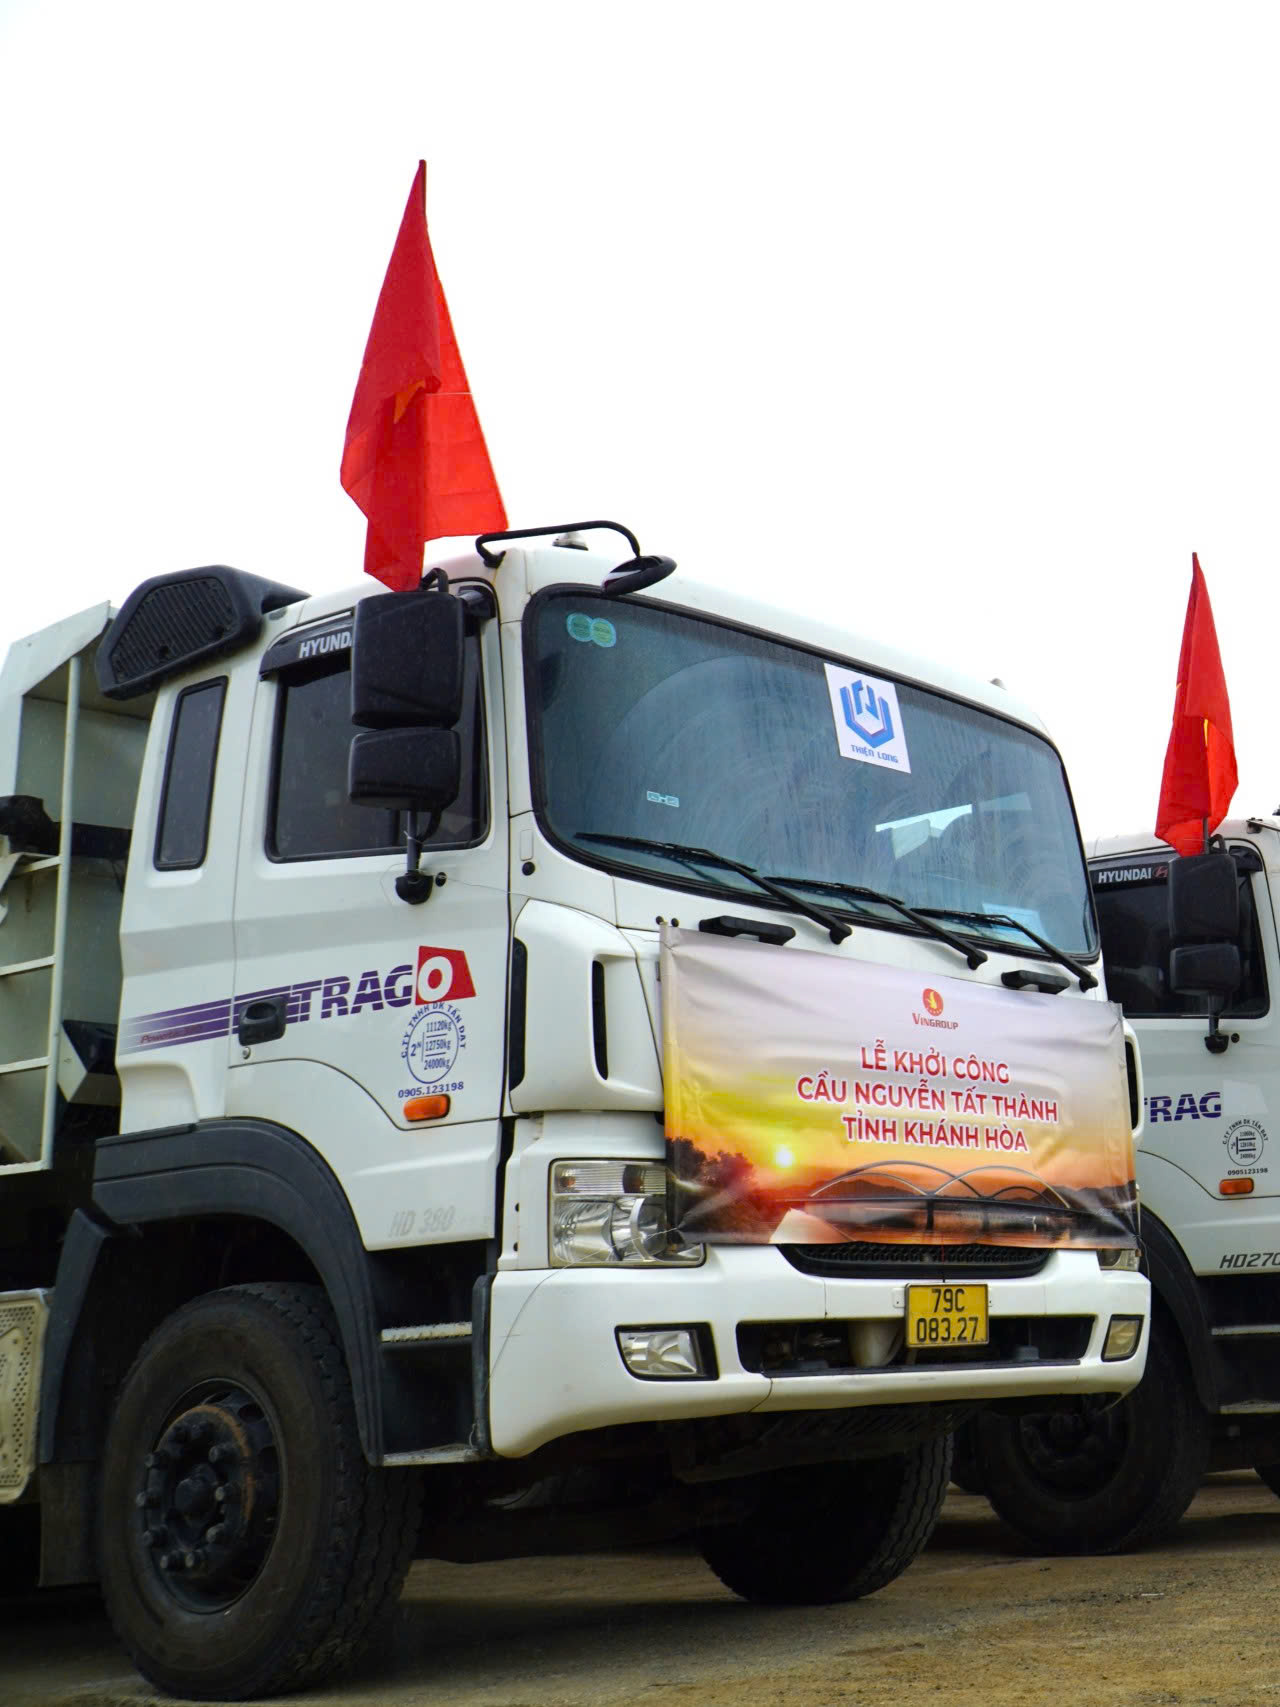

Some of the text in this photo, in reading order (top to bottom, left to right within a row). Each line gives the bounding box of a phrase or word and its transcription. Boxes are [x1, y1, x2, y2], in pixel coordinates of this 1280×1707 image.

[299, 631, 352, 658] HYUND
[1098, 867, 1152, 883] HYUNDAI
[291, 956, 453, 1024] TRAGO
[408, 1004, 430, 1028] TNHH
[861, 1039, 1009, 1084] LỄ KHỞI CÔNG
[398, 1082, 464, 1098] 0905.123198
[797, 1071, 1058, 1121] CẦU NGUYỄN TẤT THÀNH
[1144, 1092, 1221, 1122] RAG
[843, 1110, 1028, 1151] TỈNH KHÁNH HÒA
[931, 1288, 965, 1313] 79C
[916, 1316, 979, 1343] 083.27
